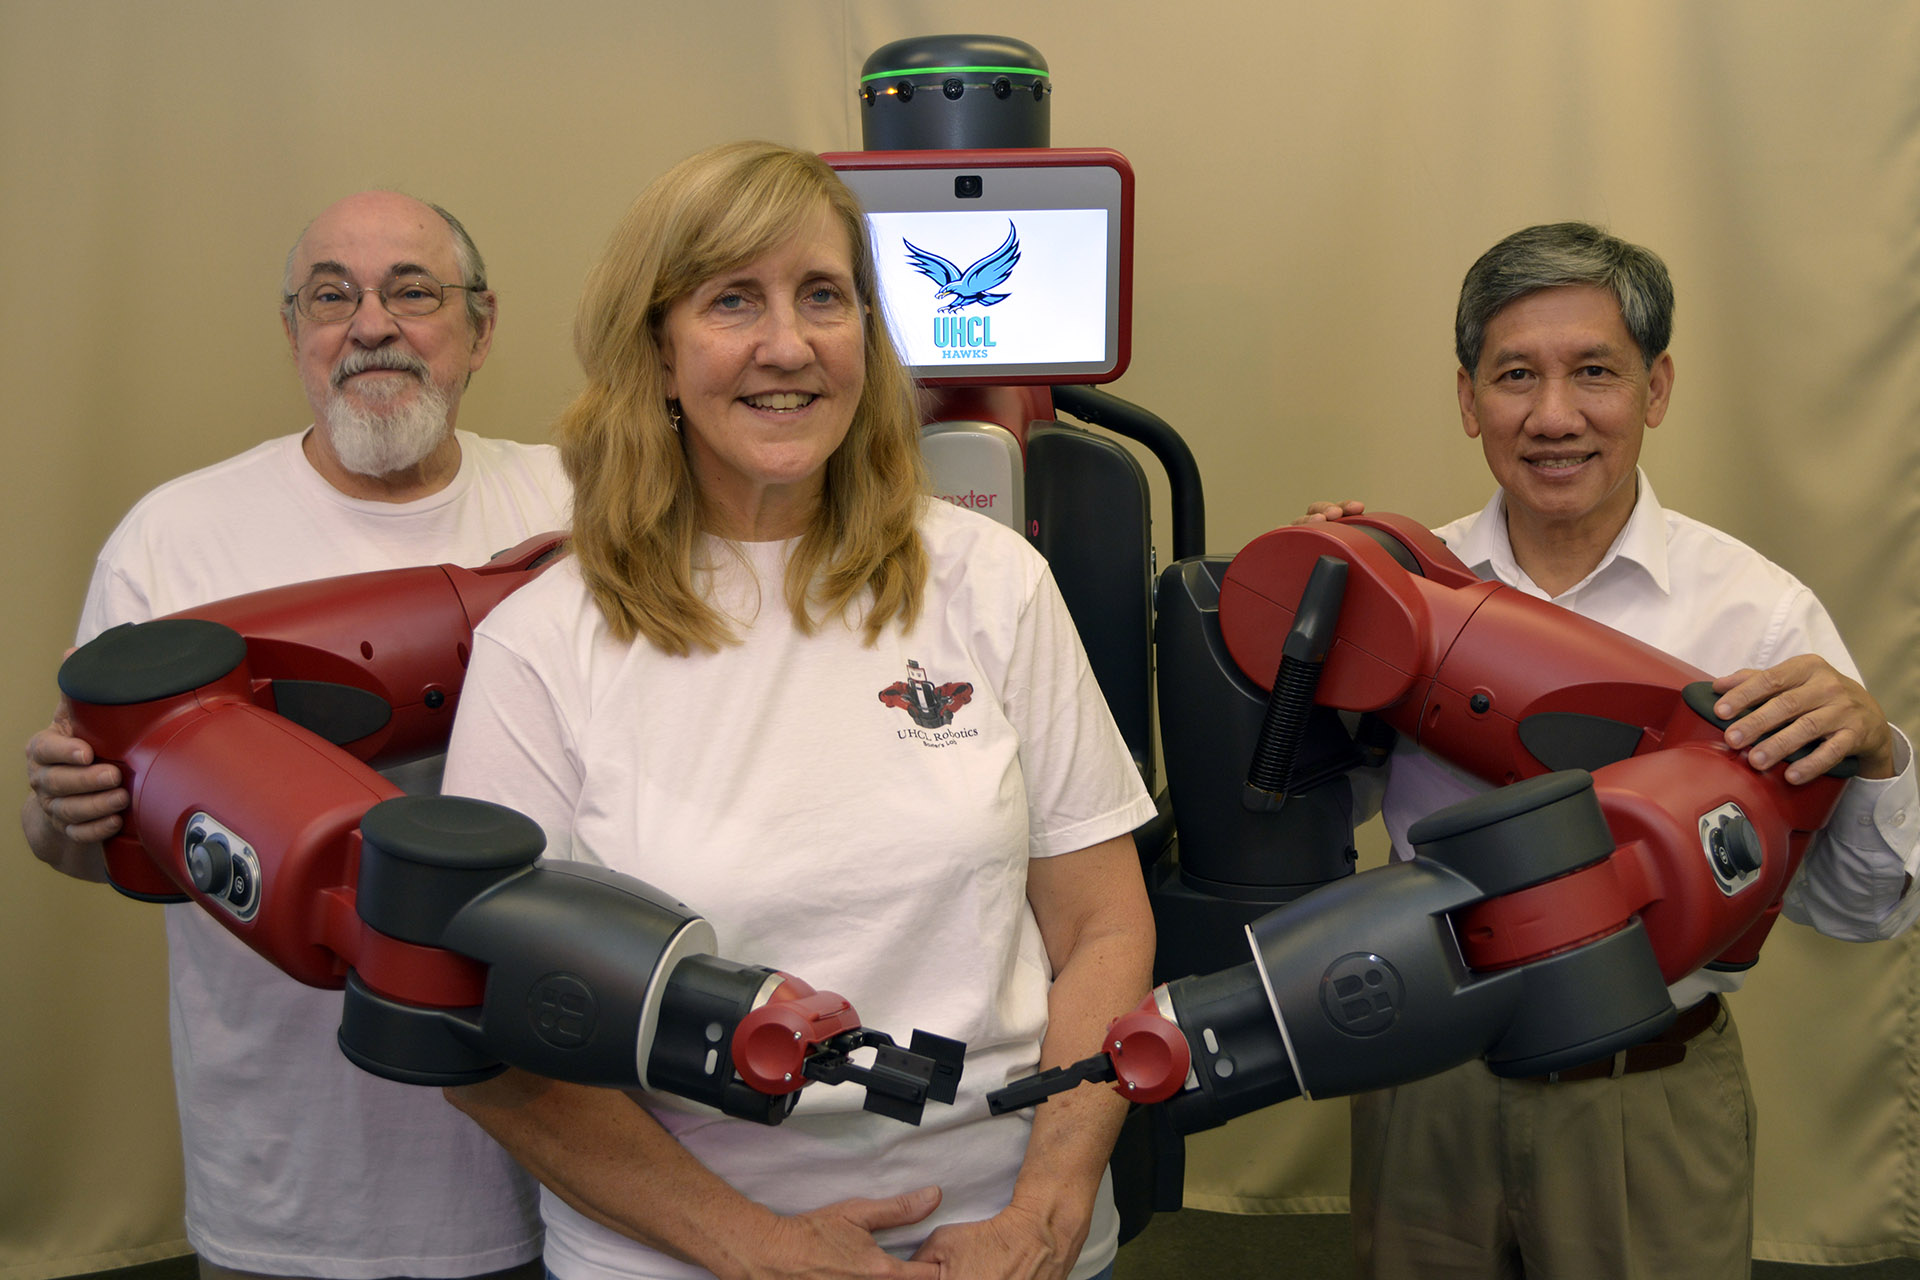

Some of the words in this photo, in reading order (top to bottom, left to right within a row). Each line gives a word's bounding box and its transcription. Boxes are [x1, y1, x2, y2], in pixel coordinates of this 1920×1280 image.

[934, 316, 997, 348] UHCL
[942, 349, 988, 359] HAWKS
[933, 490, 998, 508] axter
[897, 728, 932, 741] UHCL
[933, 728, 979, 741] Robotics
